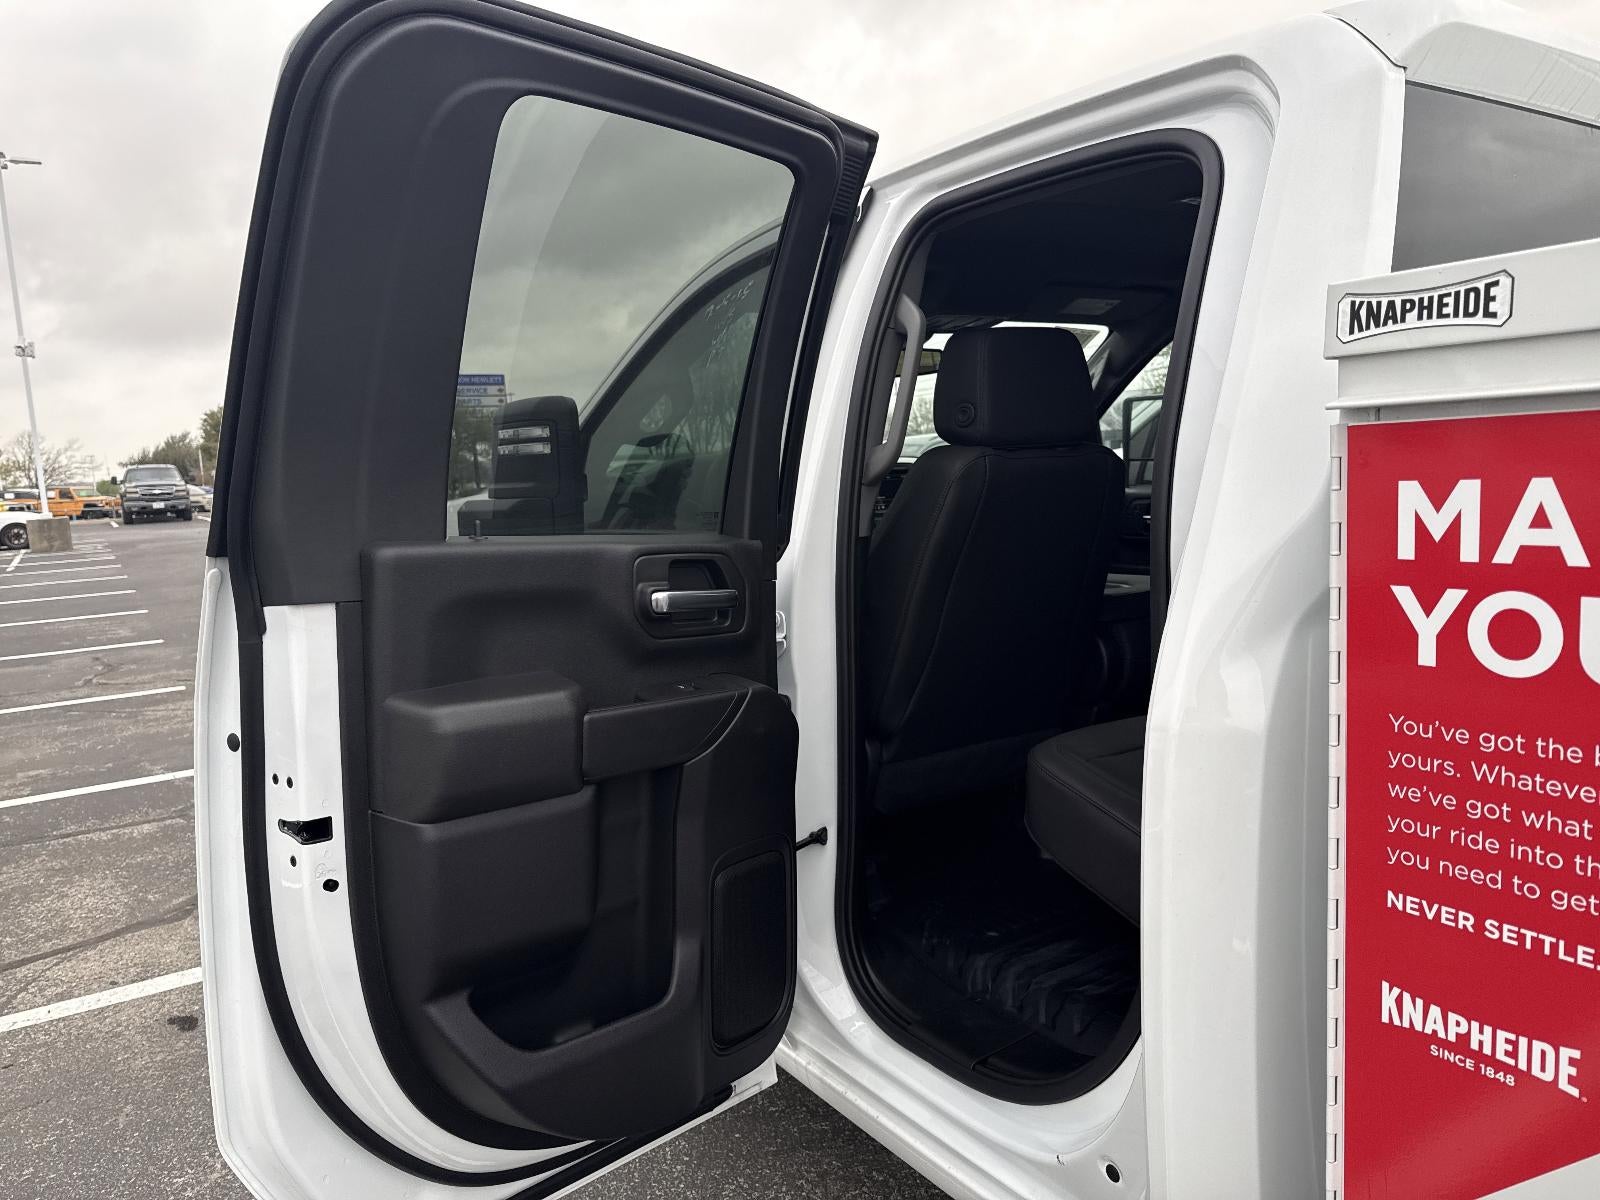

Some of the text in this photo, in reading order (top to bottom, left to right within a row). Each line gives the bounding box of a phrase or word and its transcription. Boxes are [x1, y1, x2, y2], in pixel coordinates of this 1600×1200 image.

[1348, 279, 1500, 337] KNAPHEIDE
[1390, 585, 1600, 685] YO
[1389, 714, 1470, 745] You’ve
[1479, 733, 1526, 753] got
[1536, 738, 1583, 764] the
[1388, 751, 1600, 806] yours. Whateve
[1388, 783, 1594, 841] we’ve got what
[1387, 815, 1442, 840] your
[1450, 828, 1500, 854] ride
[1510, 838, 1564, 869] into
[1387, 847, 1600, 917] you need to get
[1387, 890, 1600, 971] NEVER SETTLE.
[1381, 980, 1582, 1099] KNAPHEIDE
[1430, 1044, 1516, 1087] SINCE 1848
